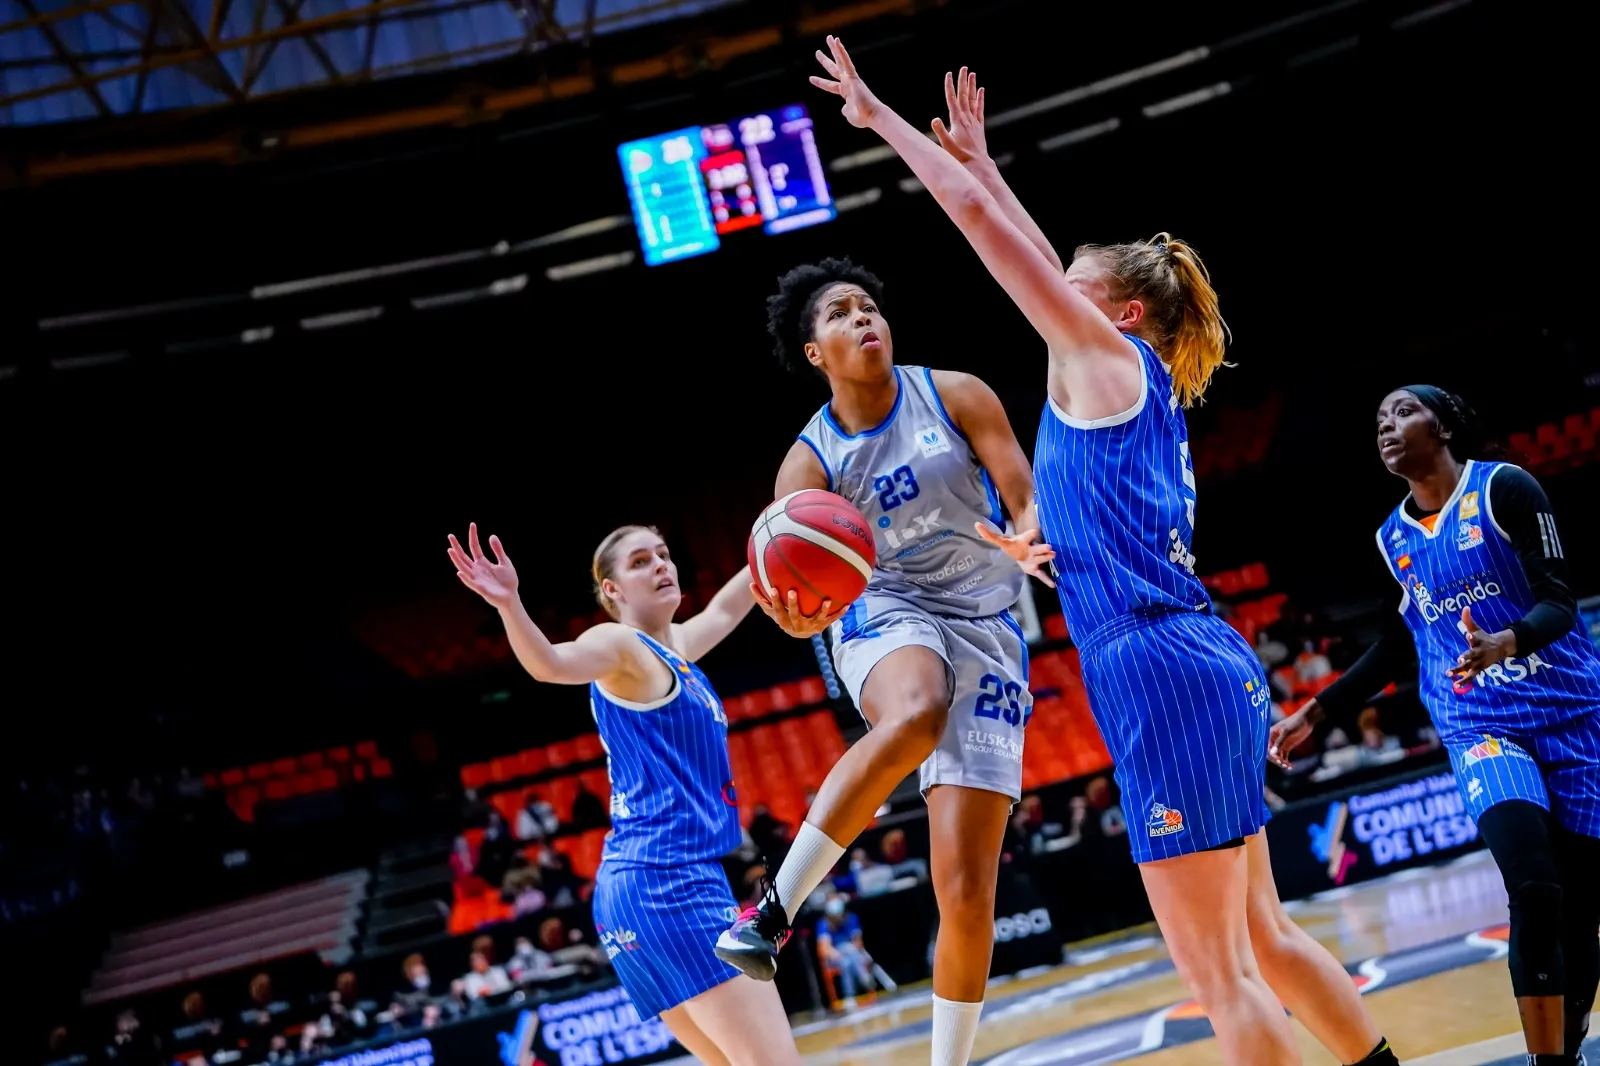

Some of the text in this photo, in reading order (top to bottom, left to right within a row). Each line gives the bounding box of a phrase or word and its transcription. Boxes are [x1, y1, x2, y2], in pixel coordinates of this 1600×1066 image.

[873, 464, 920, 512] 23
[1423, 580, 1501, 622] avenida
[974, 673, 1022, 727] 23
[1150, 823, 1184, 836] AVENIDA
[1371, 830, 1413, 866] DE
